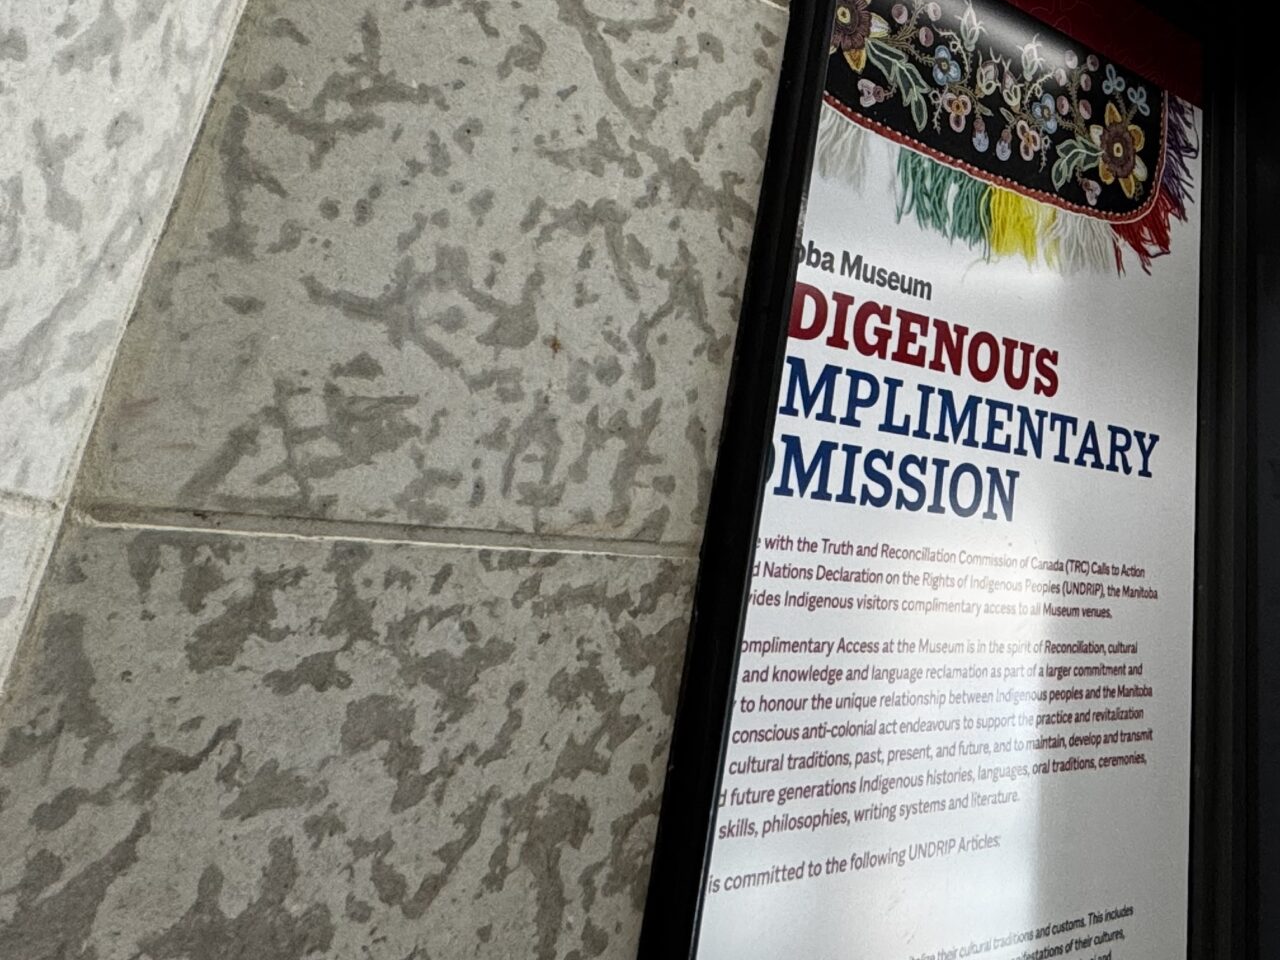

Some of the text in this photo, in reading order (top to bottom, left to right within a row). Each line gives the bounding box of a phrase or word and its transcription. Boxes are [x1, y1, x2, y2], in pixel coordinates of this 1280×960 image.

[840, 250, 932, 300] Museum
[788, 281, 1058, 397] DIGENOUS
[779, 356, 1159, 478] MPLIMENTARY
[765, 434, 1019, 522] MISSION
[765, 534, 794, 551] with
[798, 536, 818, 553] the
[822, 538, 854, 556] Truth
[856, 542, 877, 558] and
[881, 544, 956, 563] Reconciliation
[959, 550, 1017, 568] Commission
[1020, 556, 1030, 568] of
[1031, 557, 1064, 572] Canada
[1065, 559, 1090, 576] (TRC)
[1091, 562, 1110, 575] Calls
[1111, 564, 1120, 576] to
[1121, 564, 1145, 578] Action
[763, 561, 814, 580] Nations
[816, 565, 883, 584] Declaration
[886, 572, 900, 584] on
[902, 571, 920, 586] the
[922, 572, 954, 590] Rights
[956, 576, 969, 588] of
[970, 576, 1022, 593] Indigenous
[1026, 579, 1060, 596] Peoples
[1062, 581, 1105, 598] (UNDRIP),
[1107, 585, 1120, 598] the
[1122, 586, 1158, 600] Manitoba
[784, 590, 854, 612] Indigenous
[856, 594, 899, 612] visitors
[902, 598, 981, 617] complimentary
[984, 602, 1016, 615] access
[1018, 602, 1028, 615] to
[1030, 603, 1040, 616] all
[1042, 603, 1080, 618] Museum
[837, 637, 879, 654] Access
[882, 639, 894, 653] at
[897, 639, 916, 653] the
[918, 638, 964, 654] Museum
[966, 640, 975, 654] is
[976, 640, 986, 654] in
[989, 640, 1004, 654] the
[1006, 640, 1030, 656] spirit
[1033, 640, 1044, 654] of
[1045, 640, 1106, 655] Reconciliation,
[1108, 641, 1137, 654] cultural
[742, 665, 769, 682] and
[772, 665, 842, 685] knowledge
[846, 665, 869, 681] and
[871, 665, 923, 684] language
[926, 664, 988, 679] reclamation
[990, 666, 1001, 678] as
[1004, 664, 1024, 680] part
[1027, 664, 1038, 677] of
[1046, 664, 1071, 680] larger
[1074, 664, 1126, 677] commitment
[1128, 663, 1143, 676] and
[741, 696, 755, 713] to
[759, 694, 808, 712] honour
[811, 694, 833, 710] the
[836, 692, 877, 712] unique
[880, 688, 946, 709] relationship
[949, 688, 993, 704] between
[996, 688, 1047, 705] Indigenous
[1050, 687, 1083, 704] peoples
[1085, 686, 1100, 700] and
[1102, 685, 1116, 698] the
[1117, 684, 1152, 697] Manitoba
[732, 708, 1144, 744] conscious anti-colonial act endeavours to support the practice and revitalization
[729, 728, 1153, 774] cultural traditions, past, present, and future, and to maintain, develop and transmit
[730, 788, 775, 806] future
[778, 779, 856, 805] generations
[859, 775, 923, 794] Indigenous
[926, 768, 975, 786] histories,
[978, 765, 1030, 783] languages,
[1032, 760, 1050, 774] oral
[1052, 757, 1097, 774] traditions,
[1098, 752, 1146, 768] ceremonies,
[718, 818, 758, 840] skills,
[761, 808, 850, 838] philosophies,
[854, 803, 897, 822] writing
[899, 799, 946, 820] systems
[948, 794, 968, 810] and
[708, 874, 720, 894] is
[724, 860, 804, 891] committed
[808, 860, 822, 878] to
[826, 856, 848, 875] the
[850, 848, 906, 870] following
[908, 838, 956, 861] UNDRIP
[959, 937, 991, 958] cultural
[1036, 922, 1051, 939] and
[1052, 918, 1086, 936] customs.
[1088, 910, 1103, 926] This
[1105, 904, 1134, 920] includes
[1065, 939, 1074, 954] of
[1074, 934, 1092, 951] their
